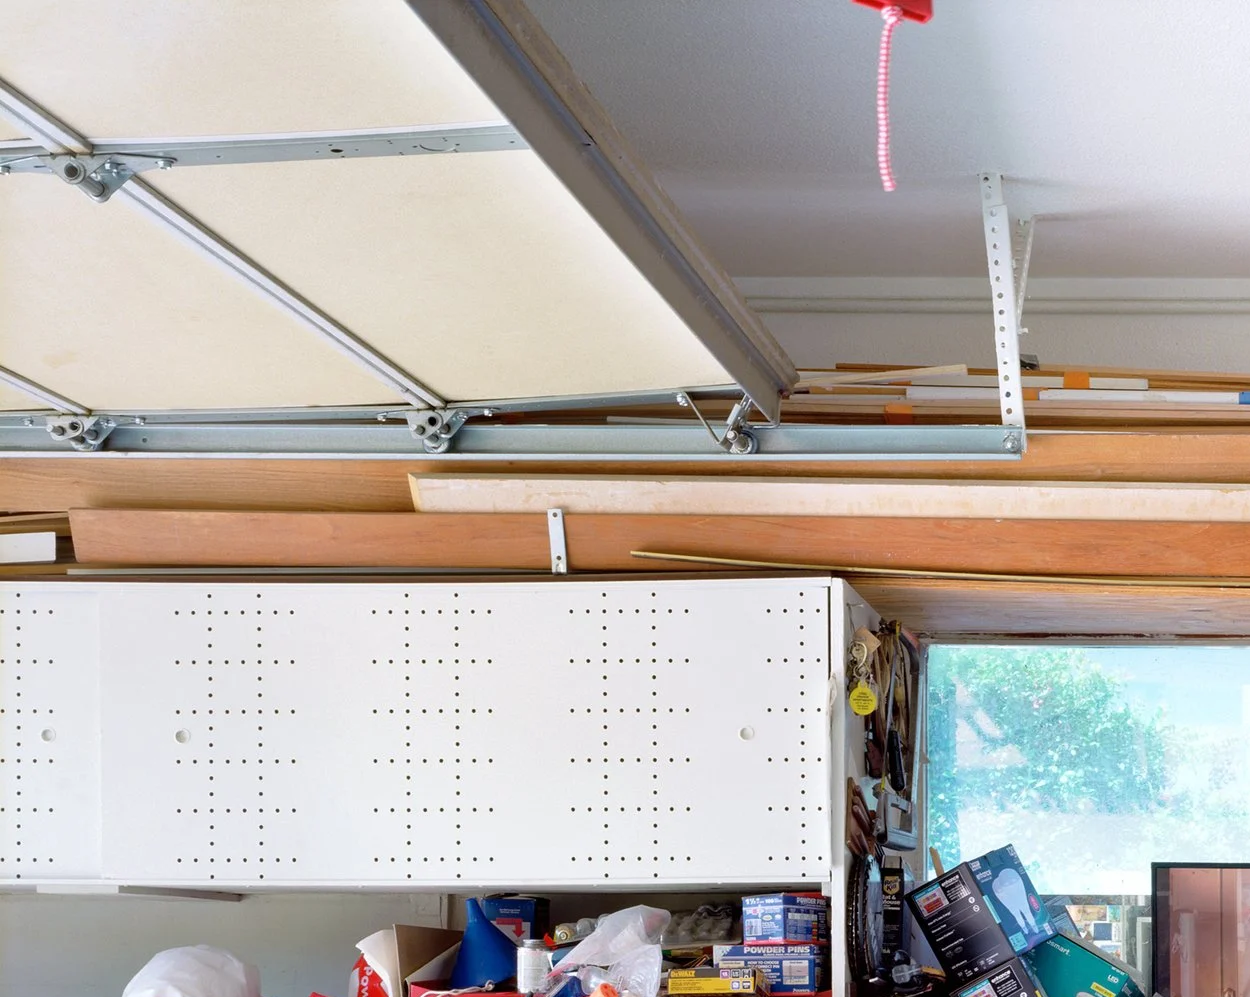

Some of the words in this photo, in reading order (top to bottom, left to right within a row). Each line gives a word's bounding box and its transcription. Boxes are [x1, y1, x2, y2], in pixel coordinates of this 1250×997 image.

[744, 946, 786, 954] POWDER
[787, 946, 810, 954] PINS
[1047, 938, 1070, 957] smart
[1108, 974, 1119, 984] LED
